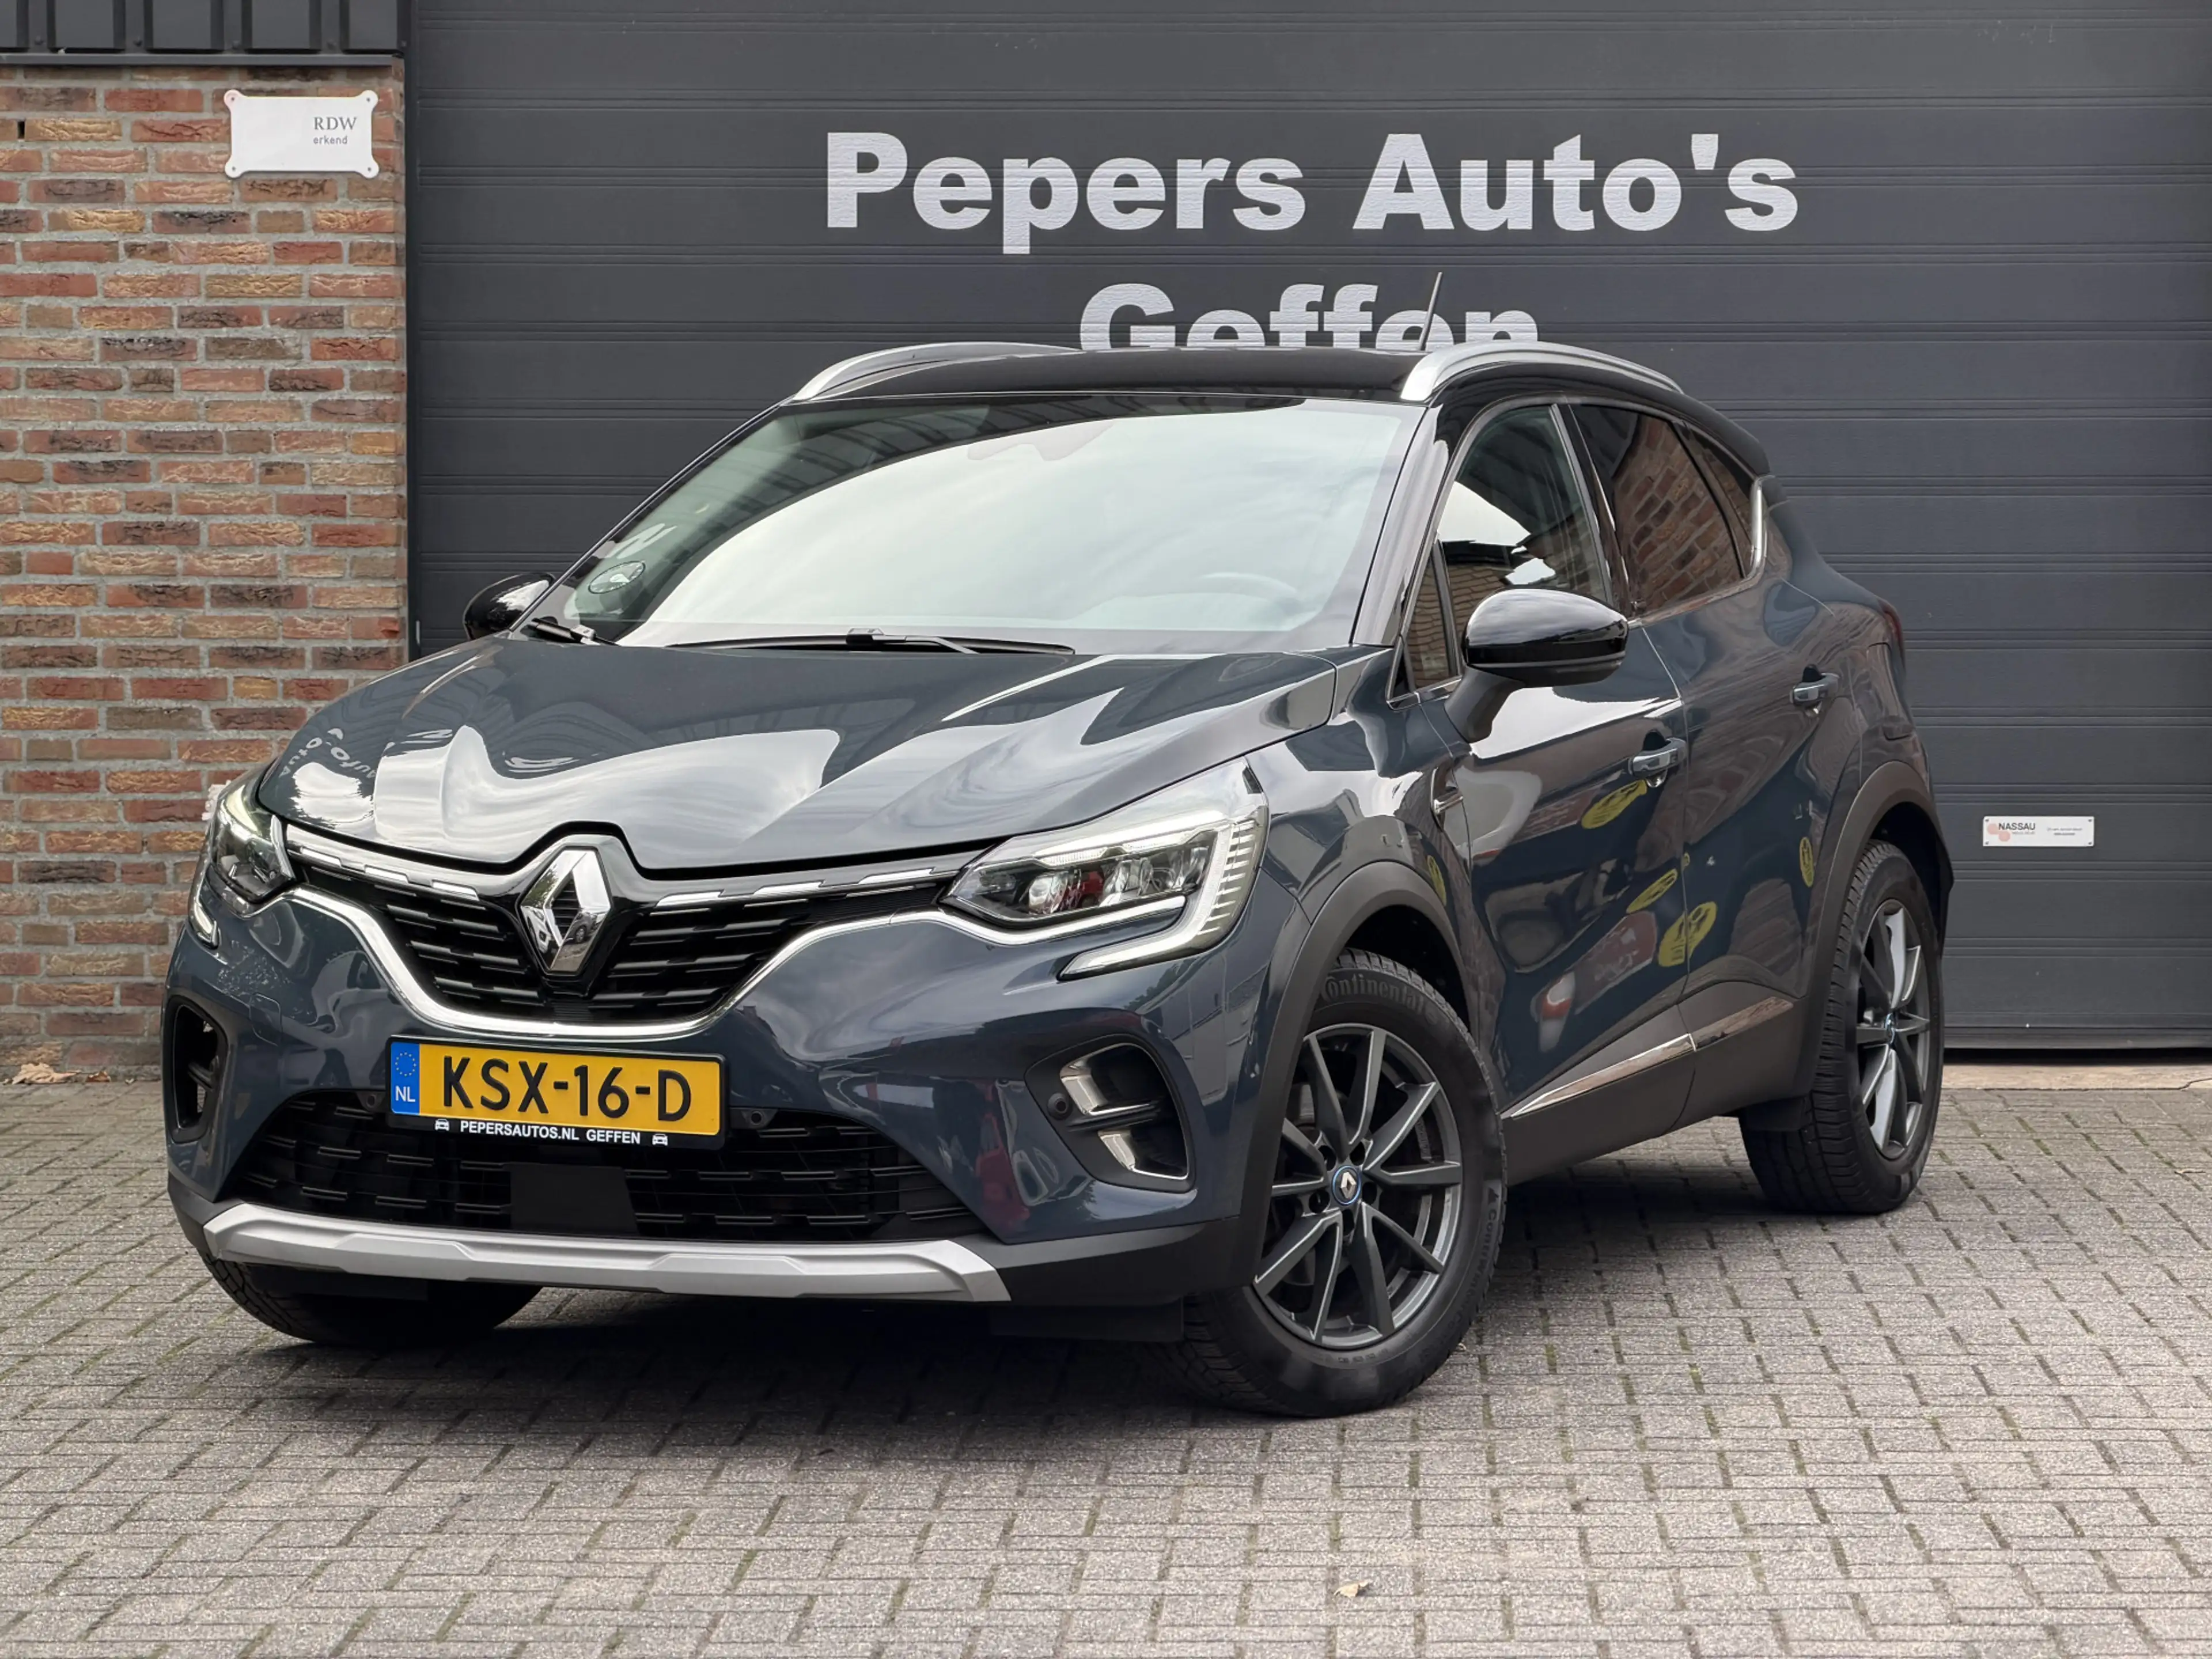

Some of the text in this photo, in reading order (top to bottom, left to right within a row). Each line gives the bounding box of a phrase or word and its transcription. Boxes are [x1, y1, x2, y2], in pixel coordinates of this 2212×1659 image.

[313, 116, 358, 130] RDW
[313, 134, 348, 145] erkend
[827, 132, 1798, 254] Pepers Auto's
[1998, 822, 2036, 830] NASSAU
[395, 1085, 415, 1103] NL
[443, 1055, 692, 1122] KSX-16-D
[460, 1120, 641, 1145] PEPERSAUTOS.NL GEFFEN
